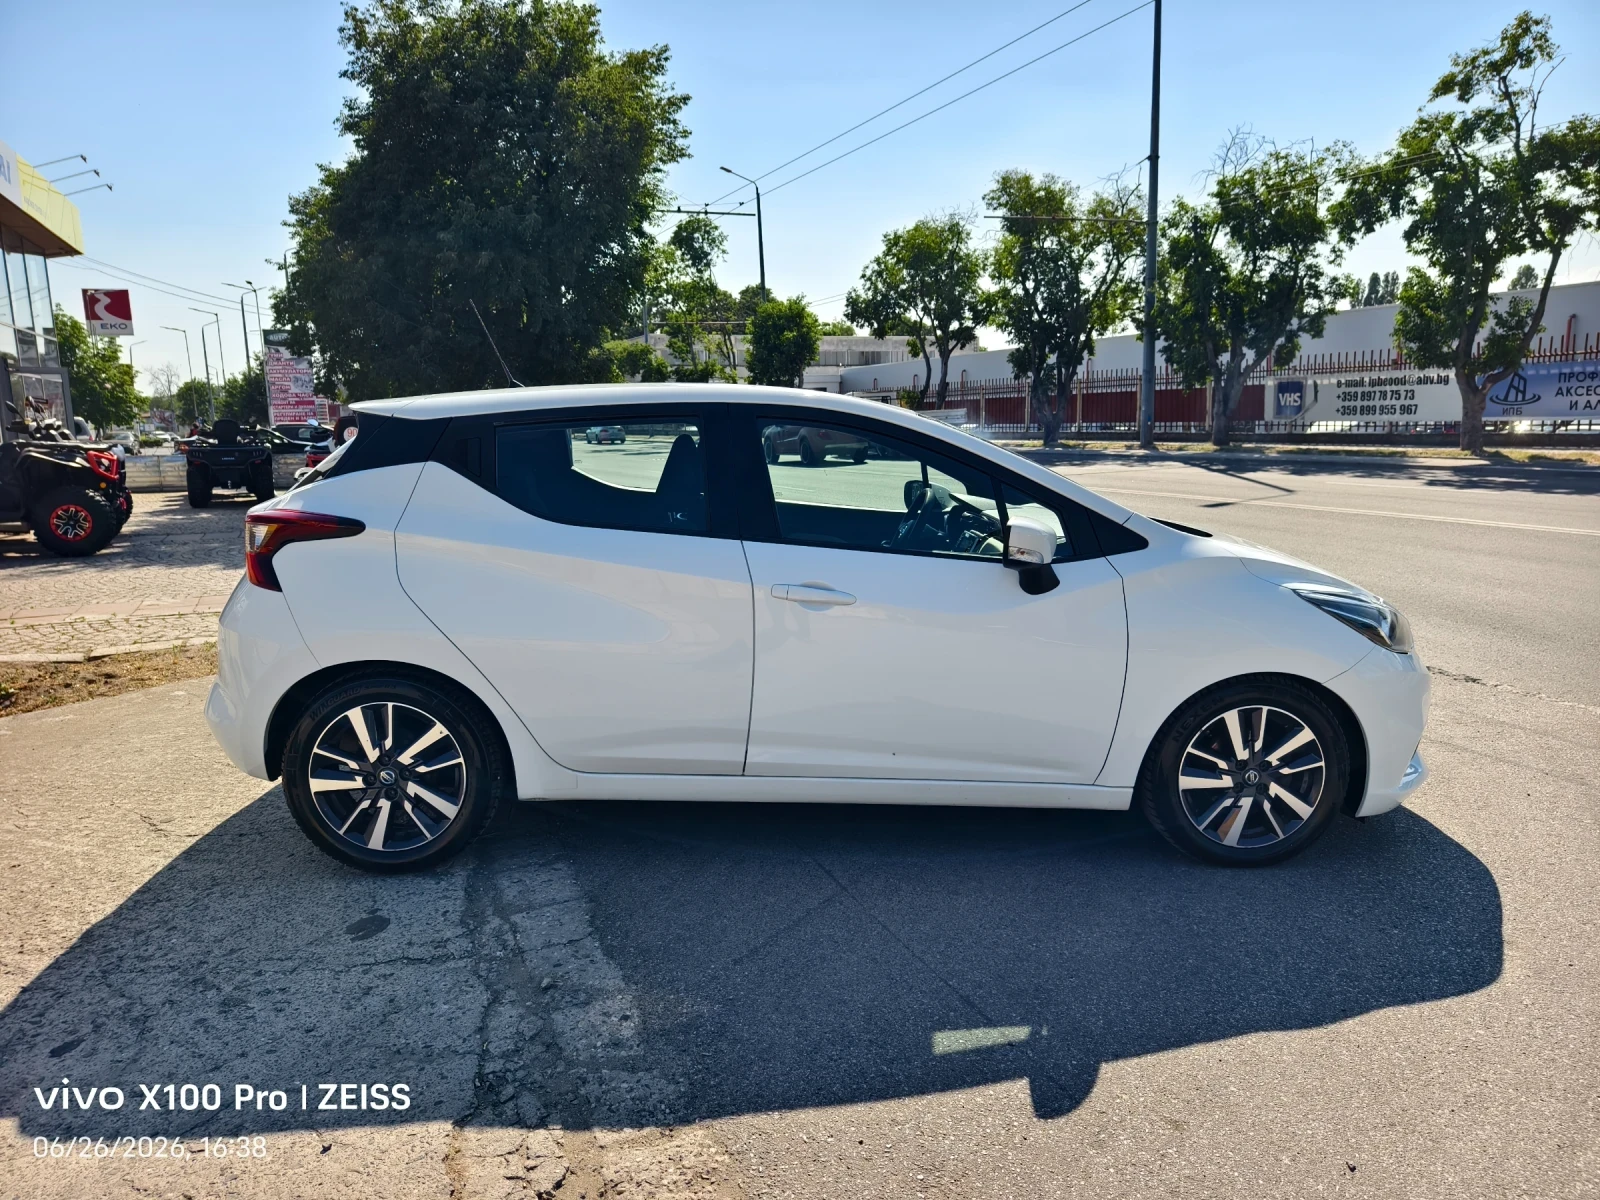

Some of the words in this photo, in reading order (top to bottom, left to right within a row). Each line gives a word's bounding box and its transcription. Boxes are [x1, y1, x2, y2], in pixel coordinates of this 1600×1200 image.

[100, 322, 128, 330] EKO
[1336, 376, 1367, 389] e-mail:
[1368, 373, 1449, 388] ipbeood@abv.bg
[1558, 371, 1600, 383] ПРОФ
[1336, 391, 1358, 402] +359
[1360, 390, 1376, 402] 897
[1378, 390, 1388, 401] 78
[1389, 389, 1401, 401] 75
[1403, 389, 1415, 401] 73
[1335, 405, 1357, 416] +359
[1359, 405, 1377, 416] 899
[1378, 404, 1397, 415] 955
[1399, 404, 1419, 415] 967
[1502, 406, 1523, 416] ИПБ
[1569, 399, 1578, 411] И
